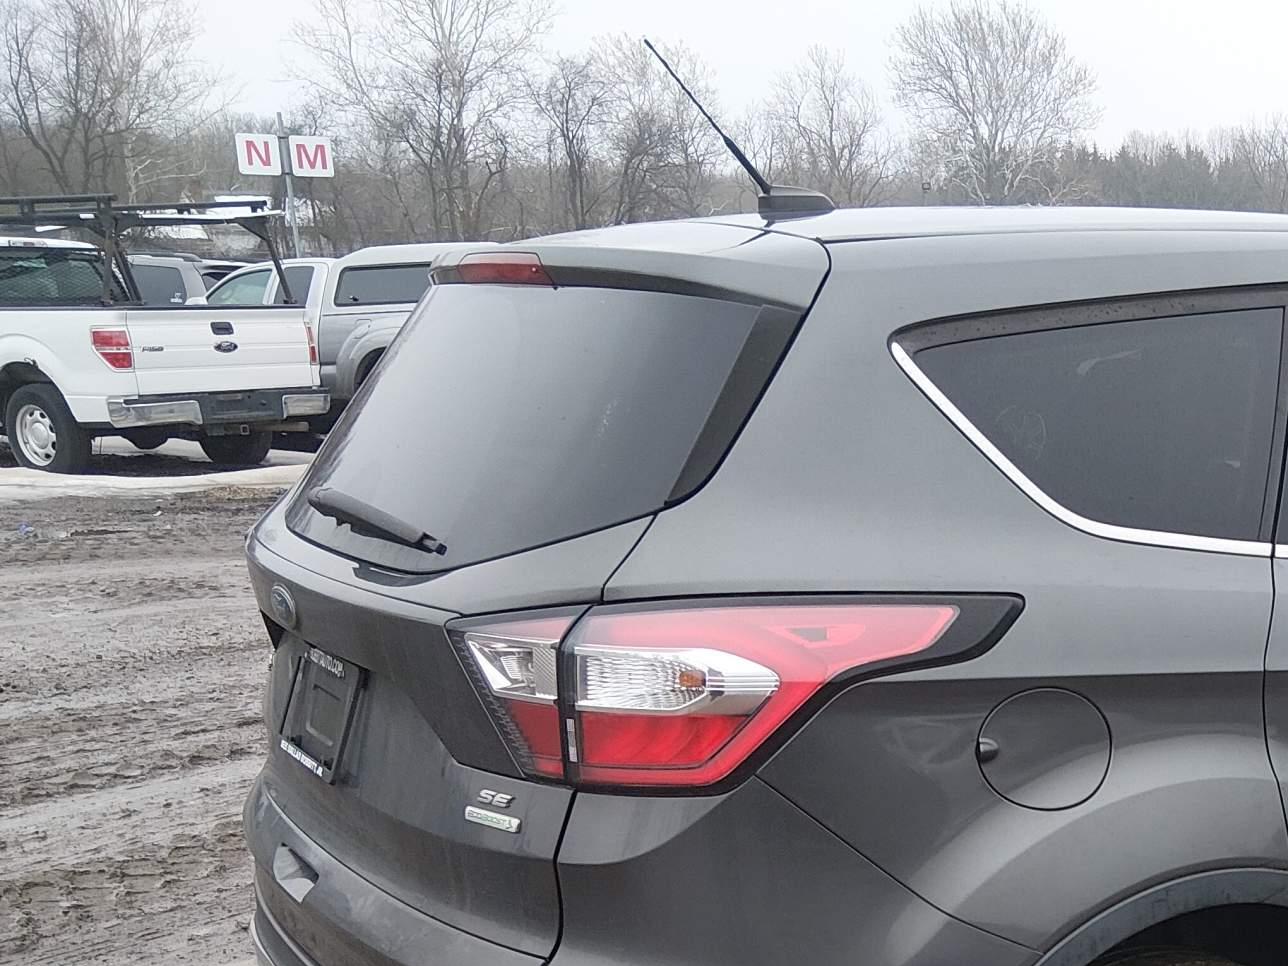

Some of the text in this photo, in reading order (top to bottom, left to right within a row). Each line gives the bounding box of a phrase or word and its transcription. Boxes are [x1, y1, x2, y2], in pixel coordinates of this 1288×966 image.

[245, 140, 272, 167] N
[295, 143, 328, 170] M
[477, 789, 513, 808] SE
